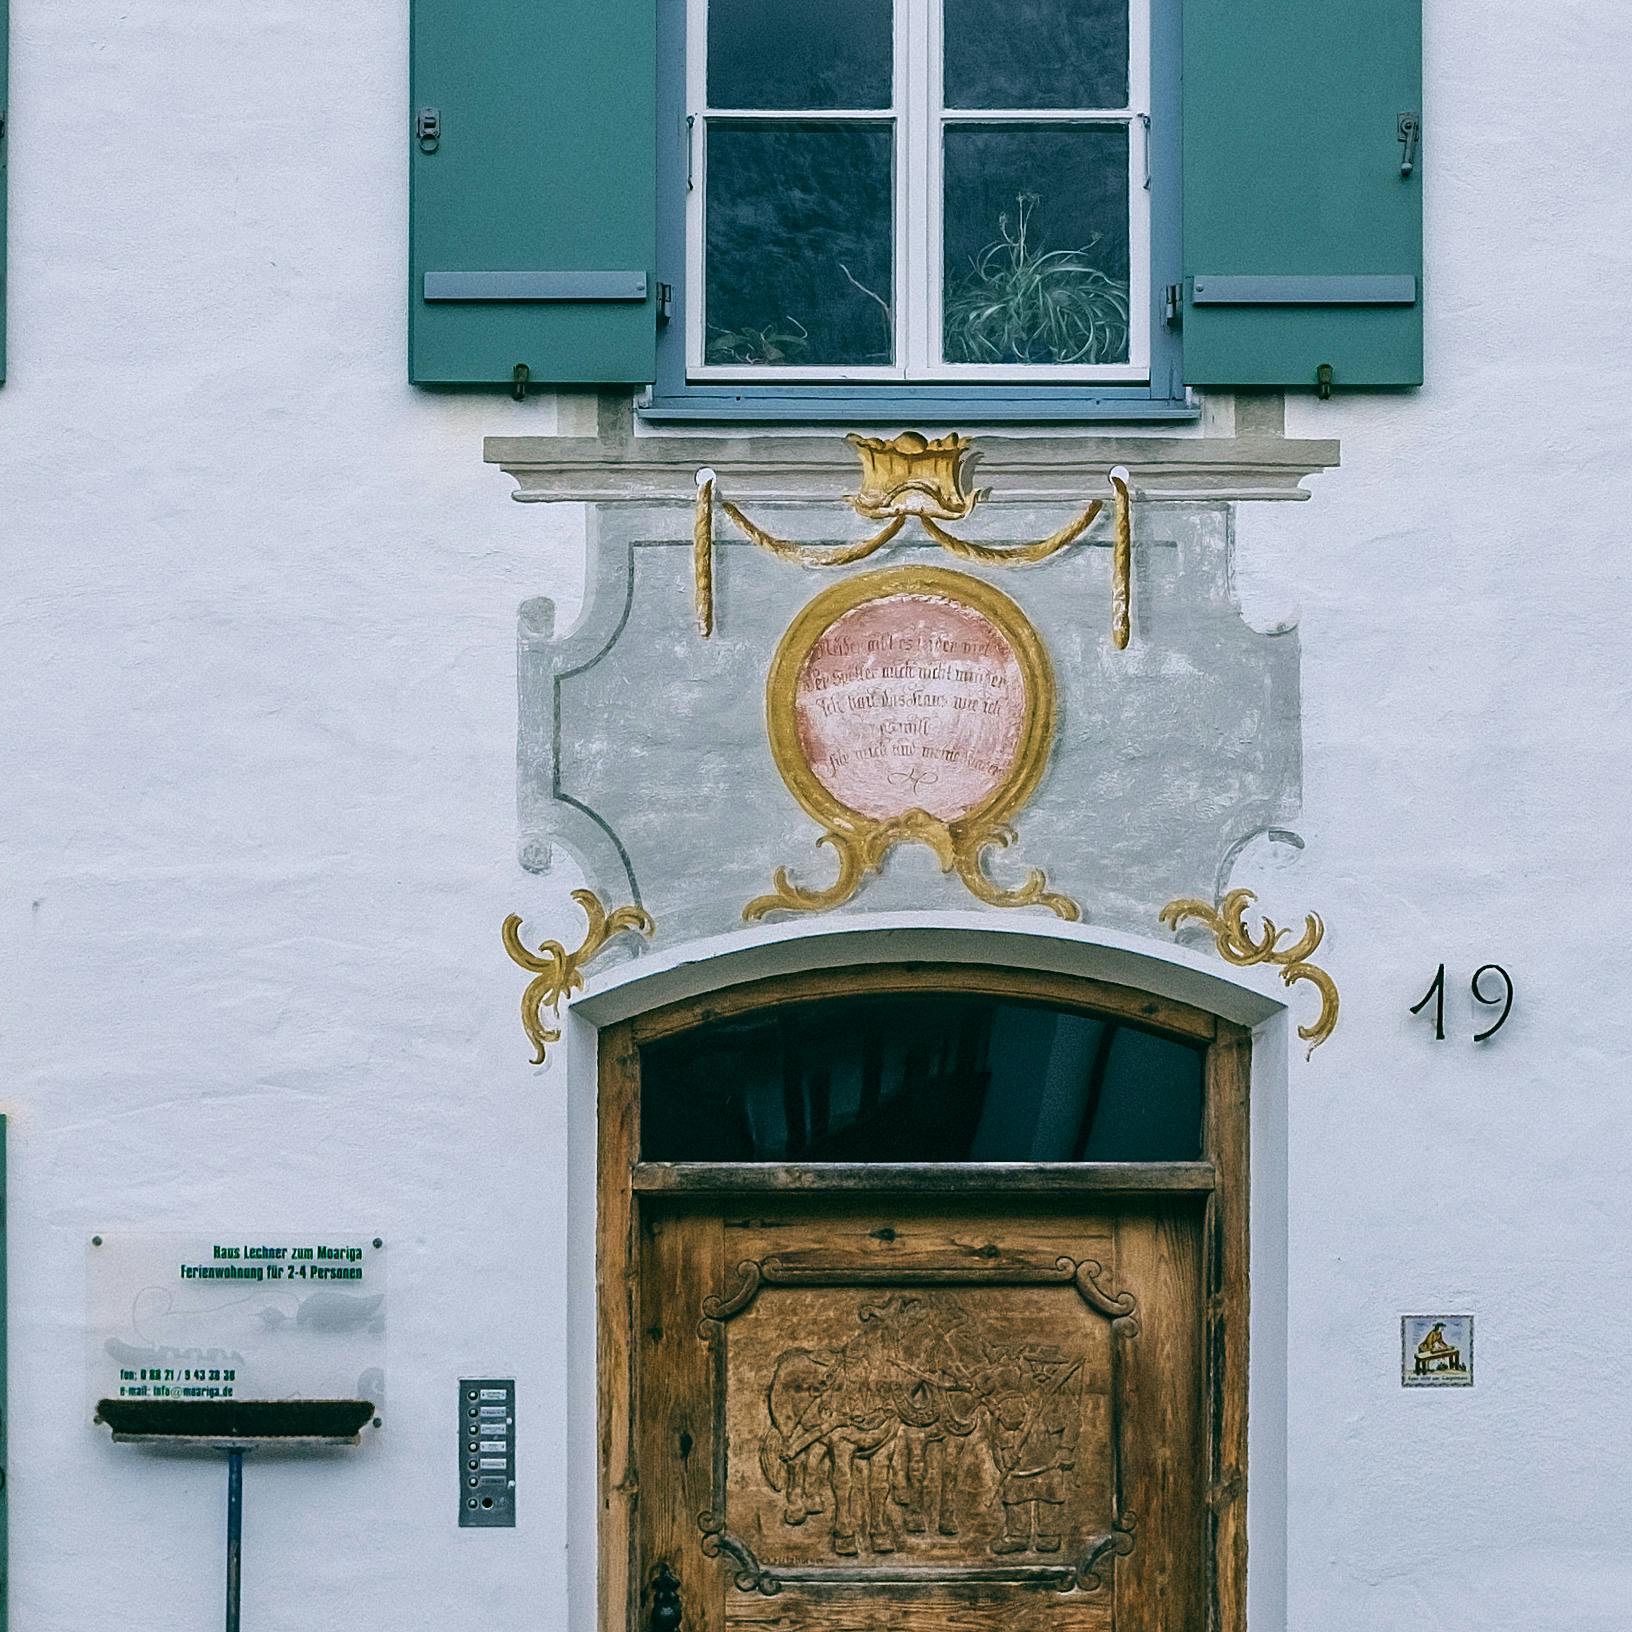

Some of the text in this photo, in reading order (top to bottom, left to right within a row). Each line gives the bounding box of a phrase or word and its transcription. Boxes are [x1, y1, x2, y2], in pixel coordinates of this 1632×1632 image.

[1409, 963, 1514, 1042] 19
[213, 1245, 363, 1263] Haus Lechner zum Moariga
[180, 1264, 363, 1281] Ferienwohnung für 2-4 Personen
[193, 1369, 206, 1381] 43
[119, 1385, 234, 1399] e-mail: info@moariga.de
